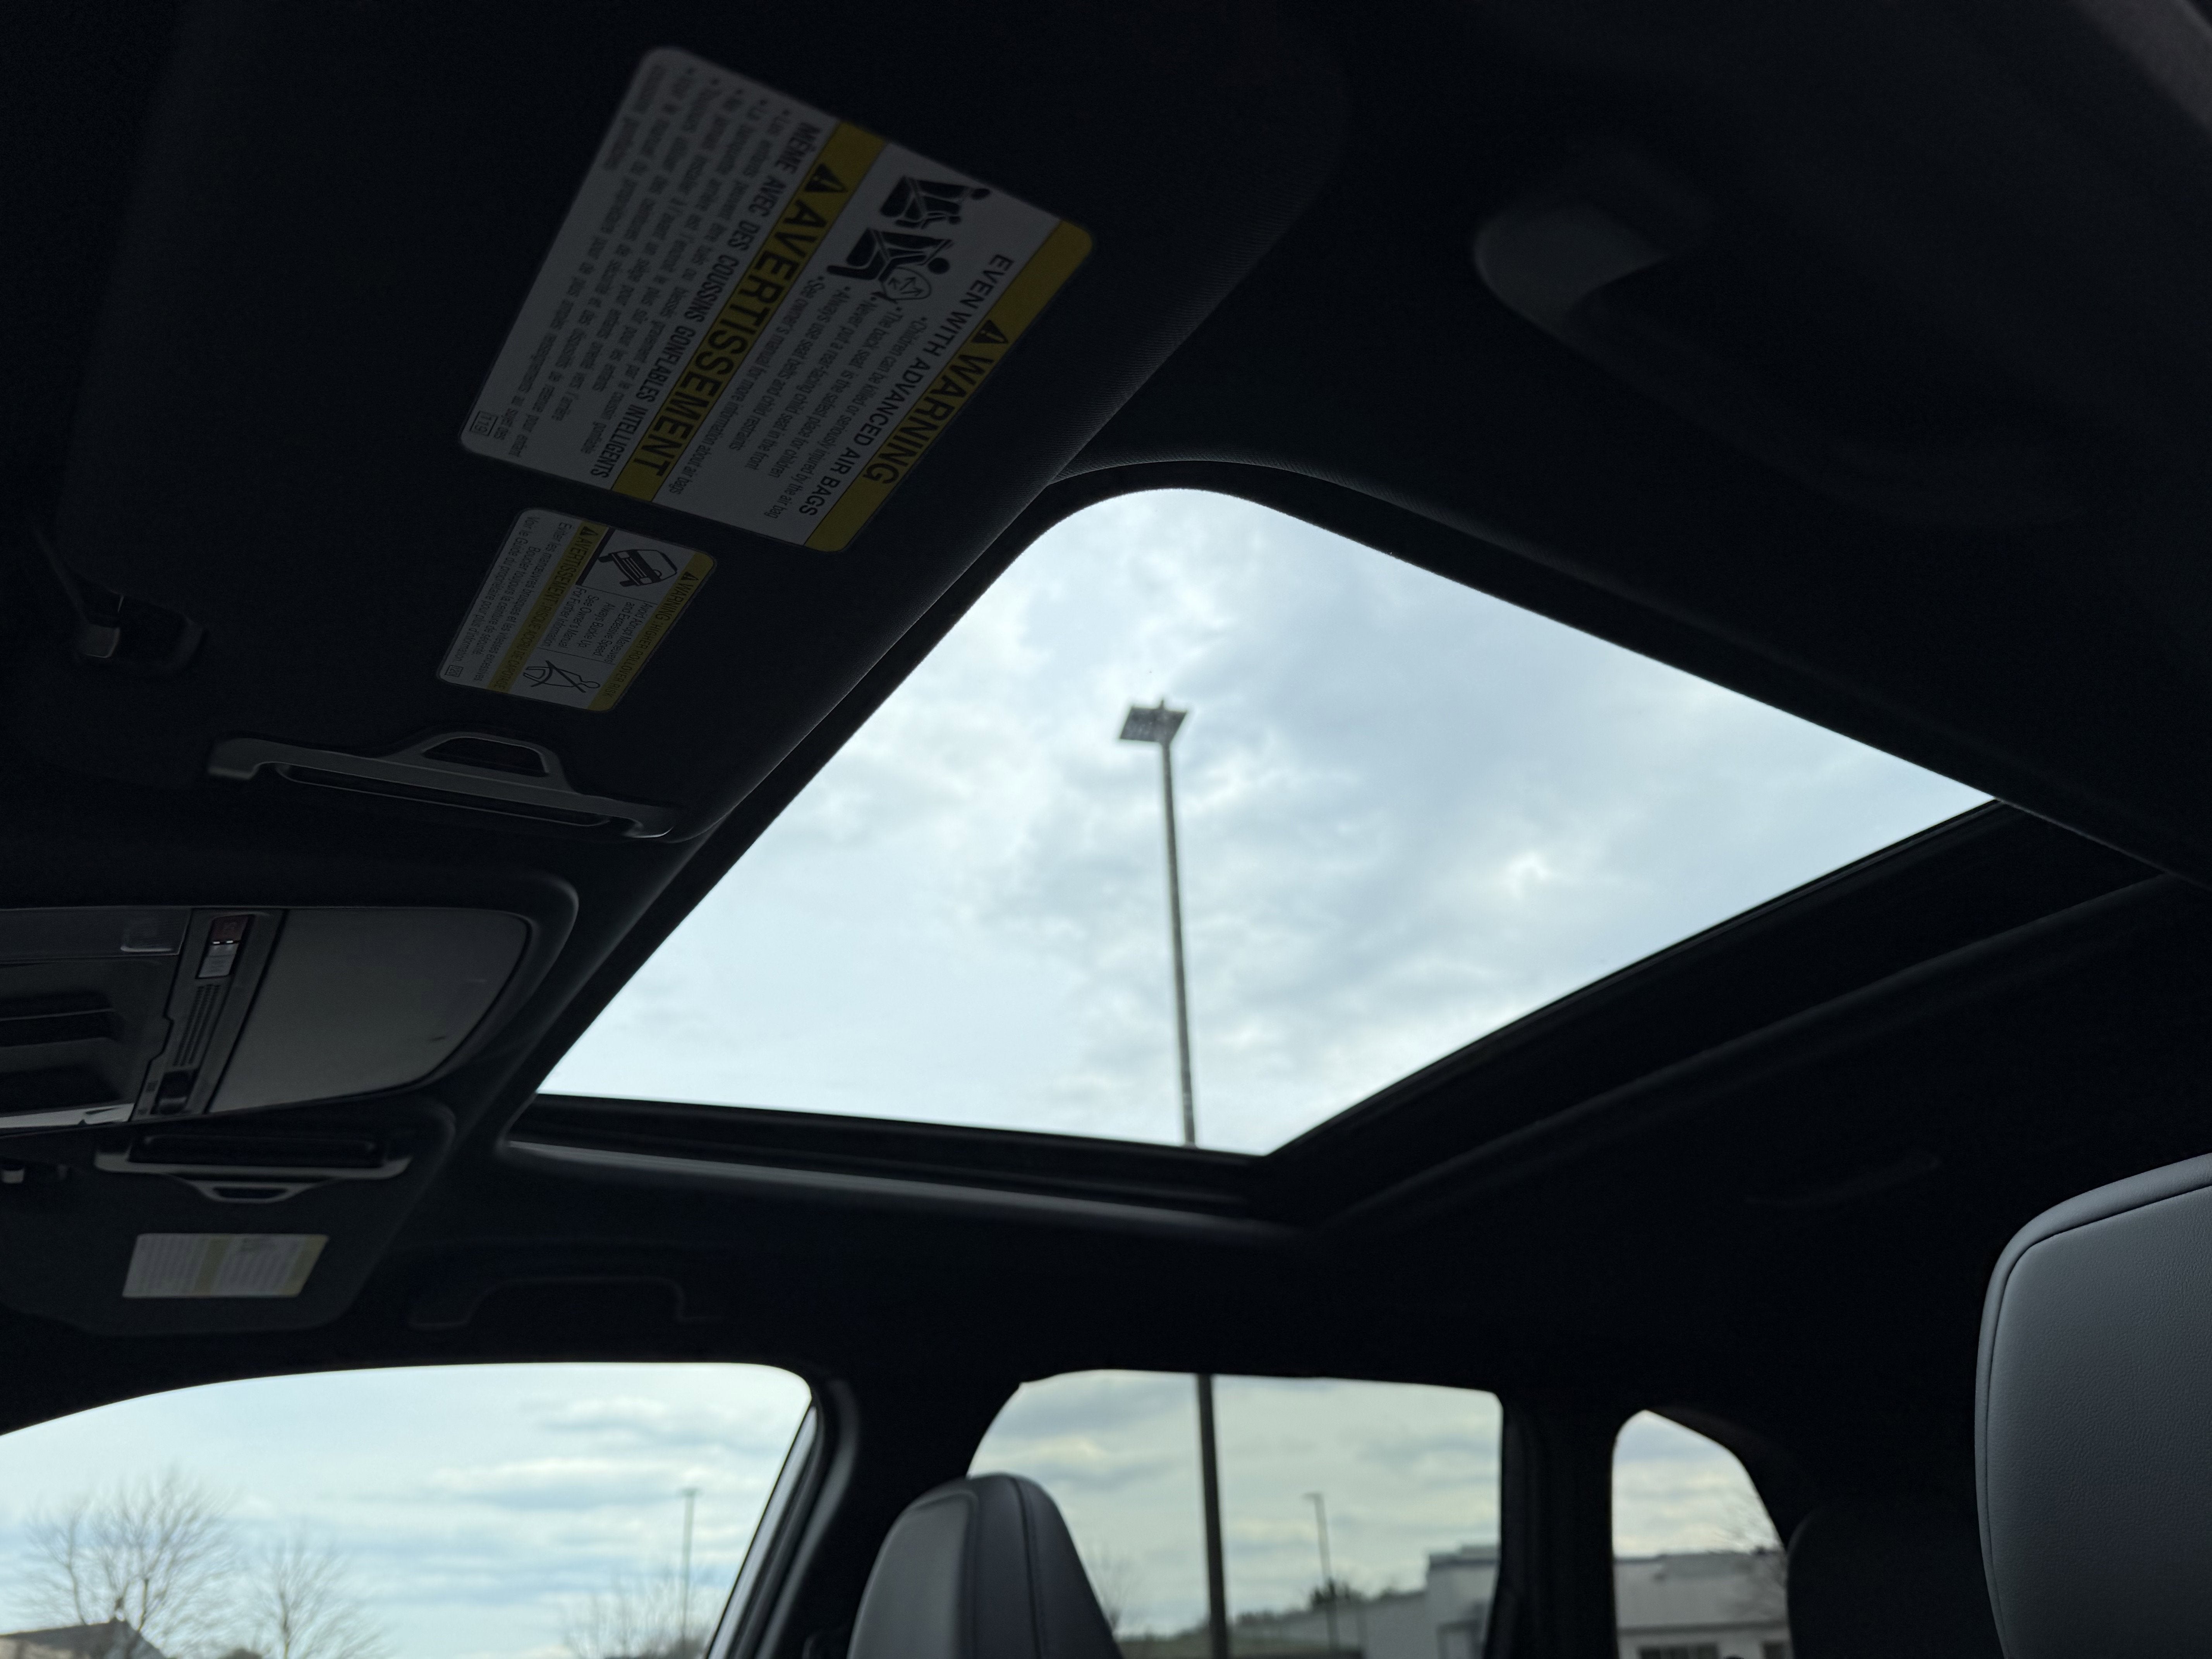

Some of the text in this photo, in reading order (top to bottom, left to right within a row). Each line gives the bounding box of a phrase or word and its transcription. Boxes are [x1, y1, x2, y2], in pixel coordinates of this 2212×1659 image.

[775, 121, 827, 175] MÊME
[747, 175, 788, 218] AVEC
[726, 219, 762, 252] DES
[683, 253, 741, 324] COUSSINS
[630, 200, 832, 476] AVERTISSEMENT
[635, 324, 698, 403] GONFLABLES
[797, 253, 1015, 516] EVEN WITH ADVANCED AIR BAGS
[473, 414, 493, 433] 119
[862, 350, 994, 486] WARNING
[589, 404, 649, 479] INTELLIGENTS
[583, 595, 599, 607] See
[591, 601, 616, 622] Always
[621, 602, 637, 614] and
[528, 605, 552, 629] RISQUE
[583, 622, 603, 640] Buckle
[604, 613, 630, 639] Excessive
[557, 629, 579, 648] Manual
[604, 603, 653, 663] Avoid Abrupt Maneuvers
[636, 623, 662, 649] HIGHER
[510, 650, 526, 660] DE
[612, 649, 644, 682] ROLLOVER
[602, 683, 620, 697] RISK
